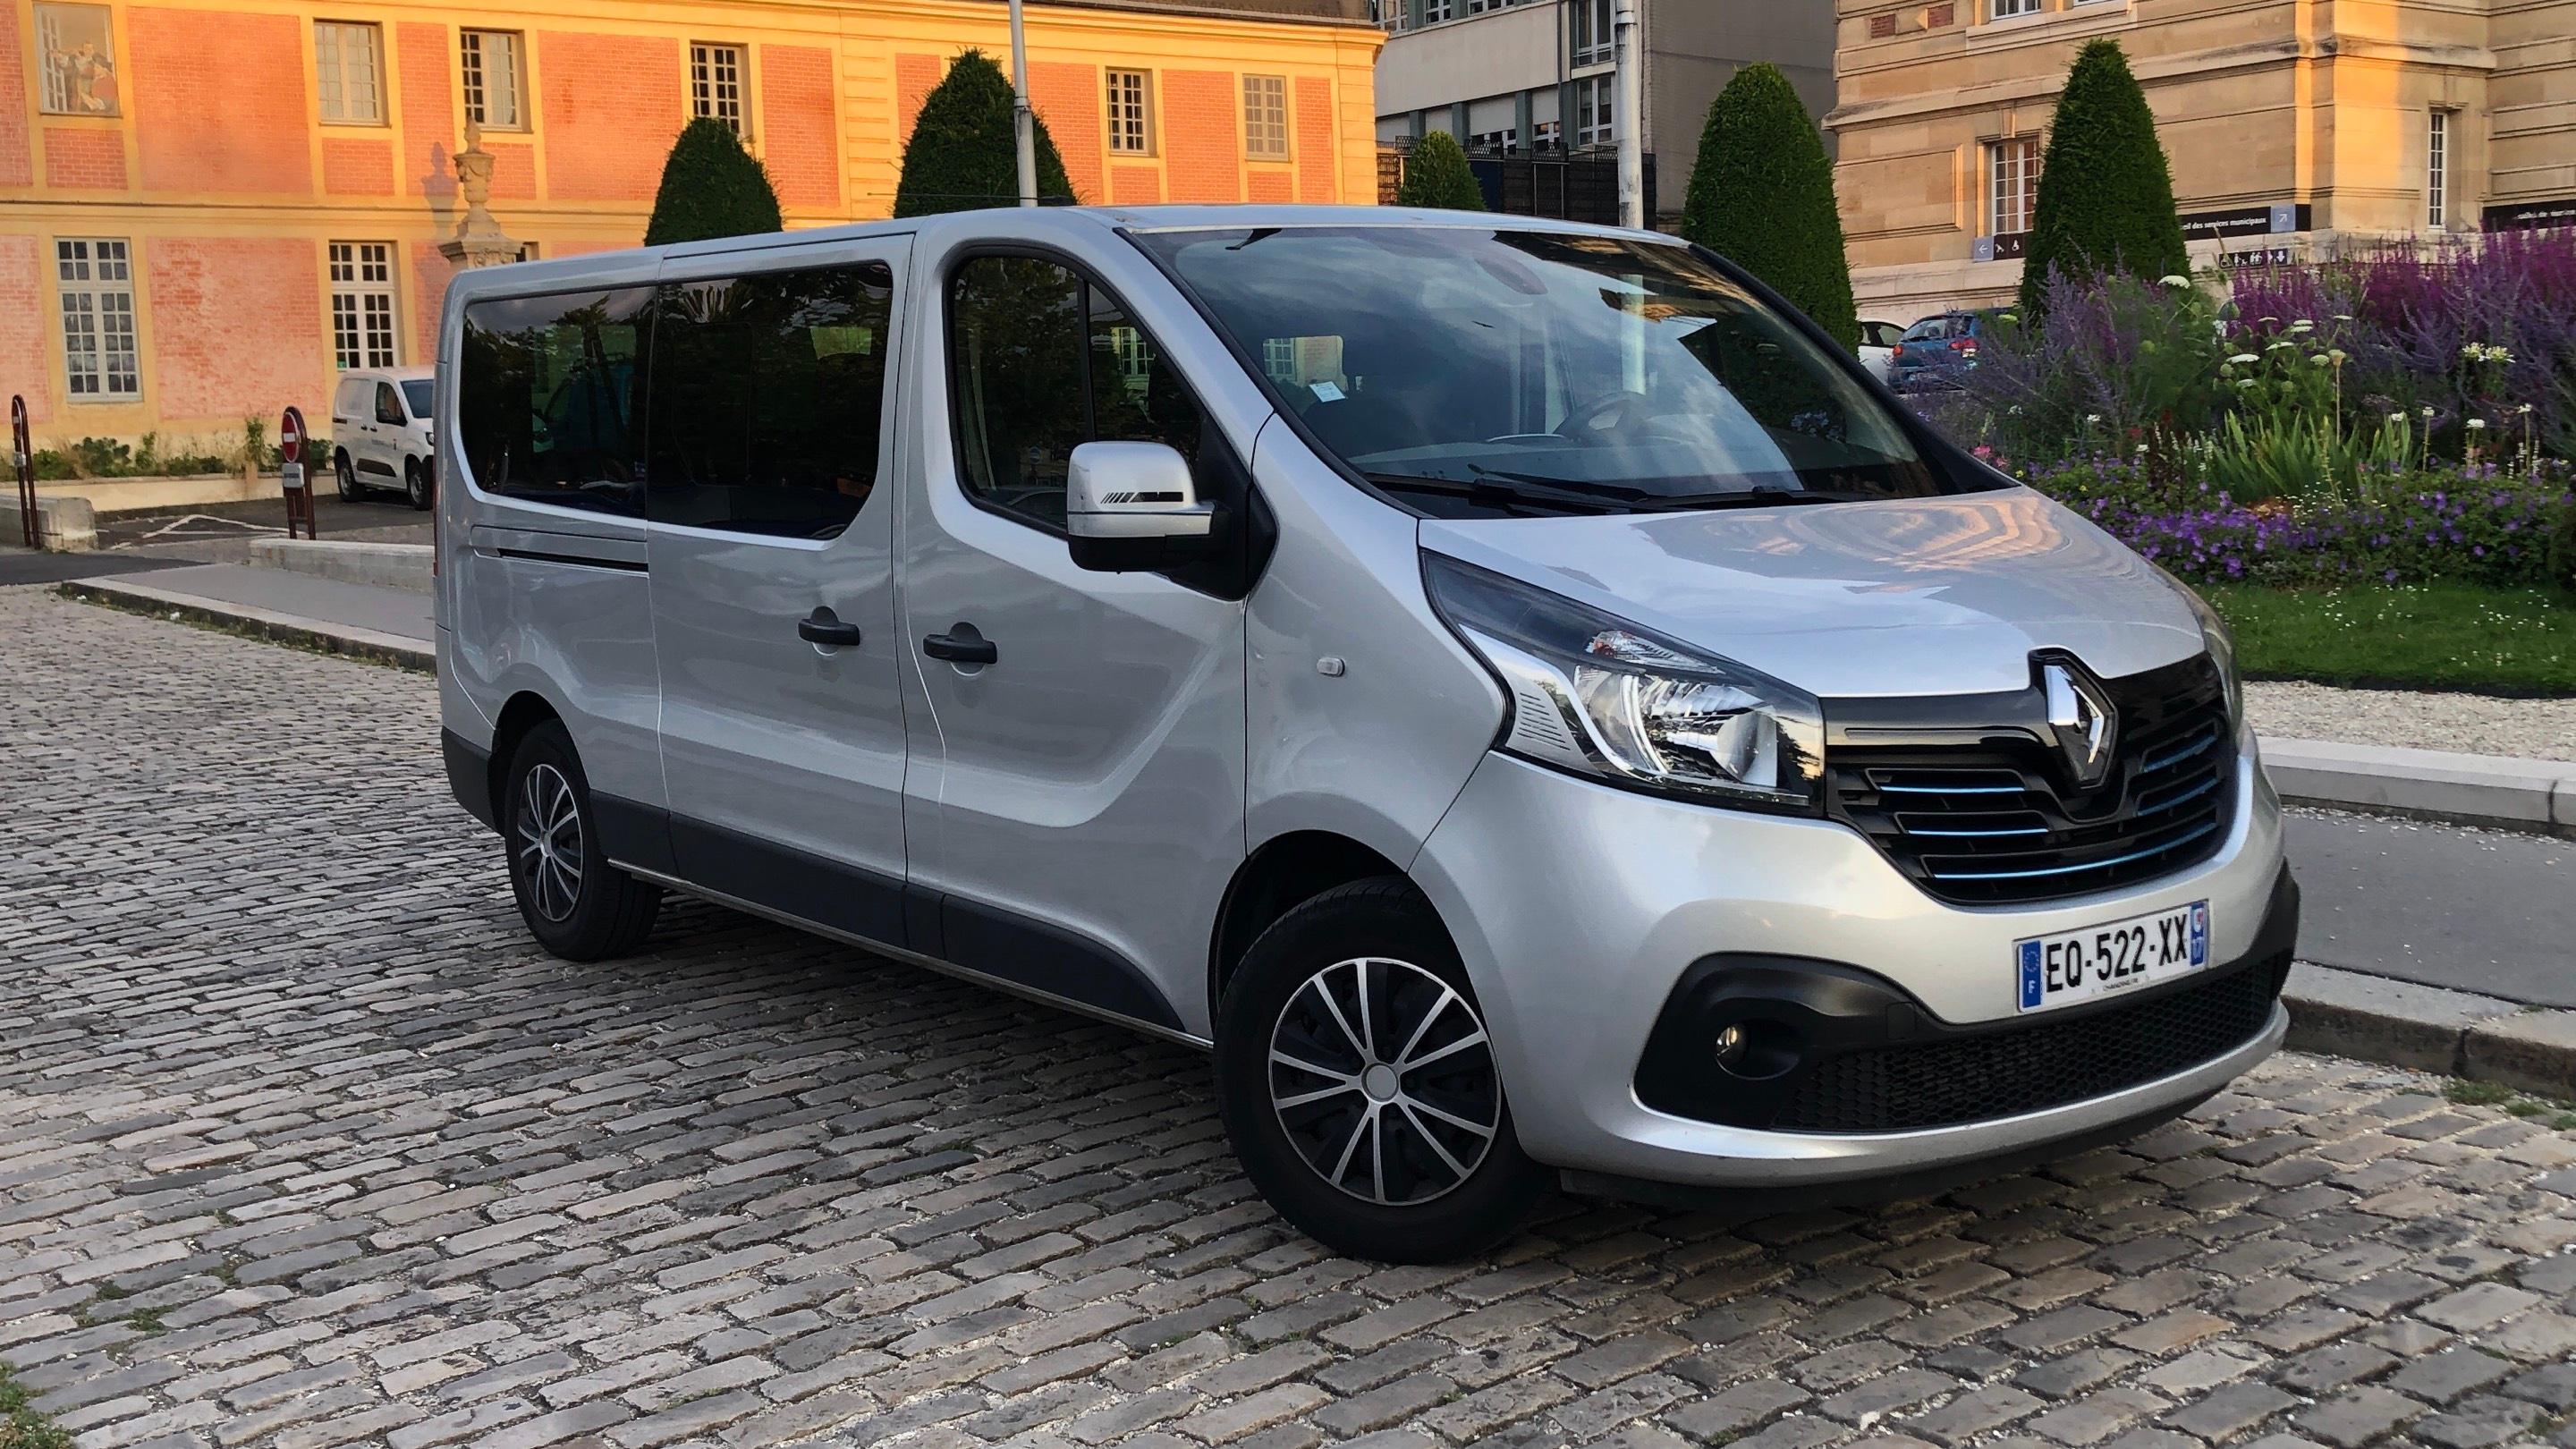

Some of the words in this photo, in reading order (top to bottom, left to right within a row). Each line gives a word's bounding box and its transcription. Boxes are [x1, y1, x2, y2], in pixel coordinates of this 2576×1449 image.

[2182, 222, 2191, 231] eil
[2192, 222, 2203, 230] des
[2205, 220, 2229, 229] services
[2230, 217, 2267, 226] municipaux
[2046, 914, 2188, 993] EQ-522-XX
[2028, 979, 2036, 995] F
